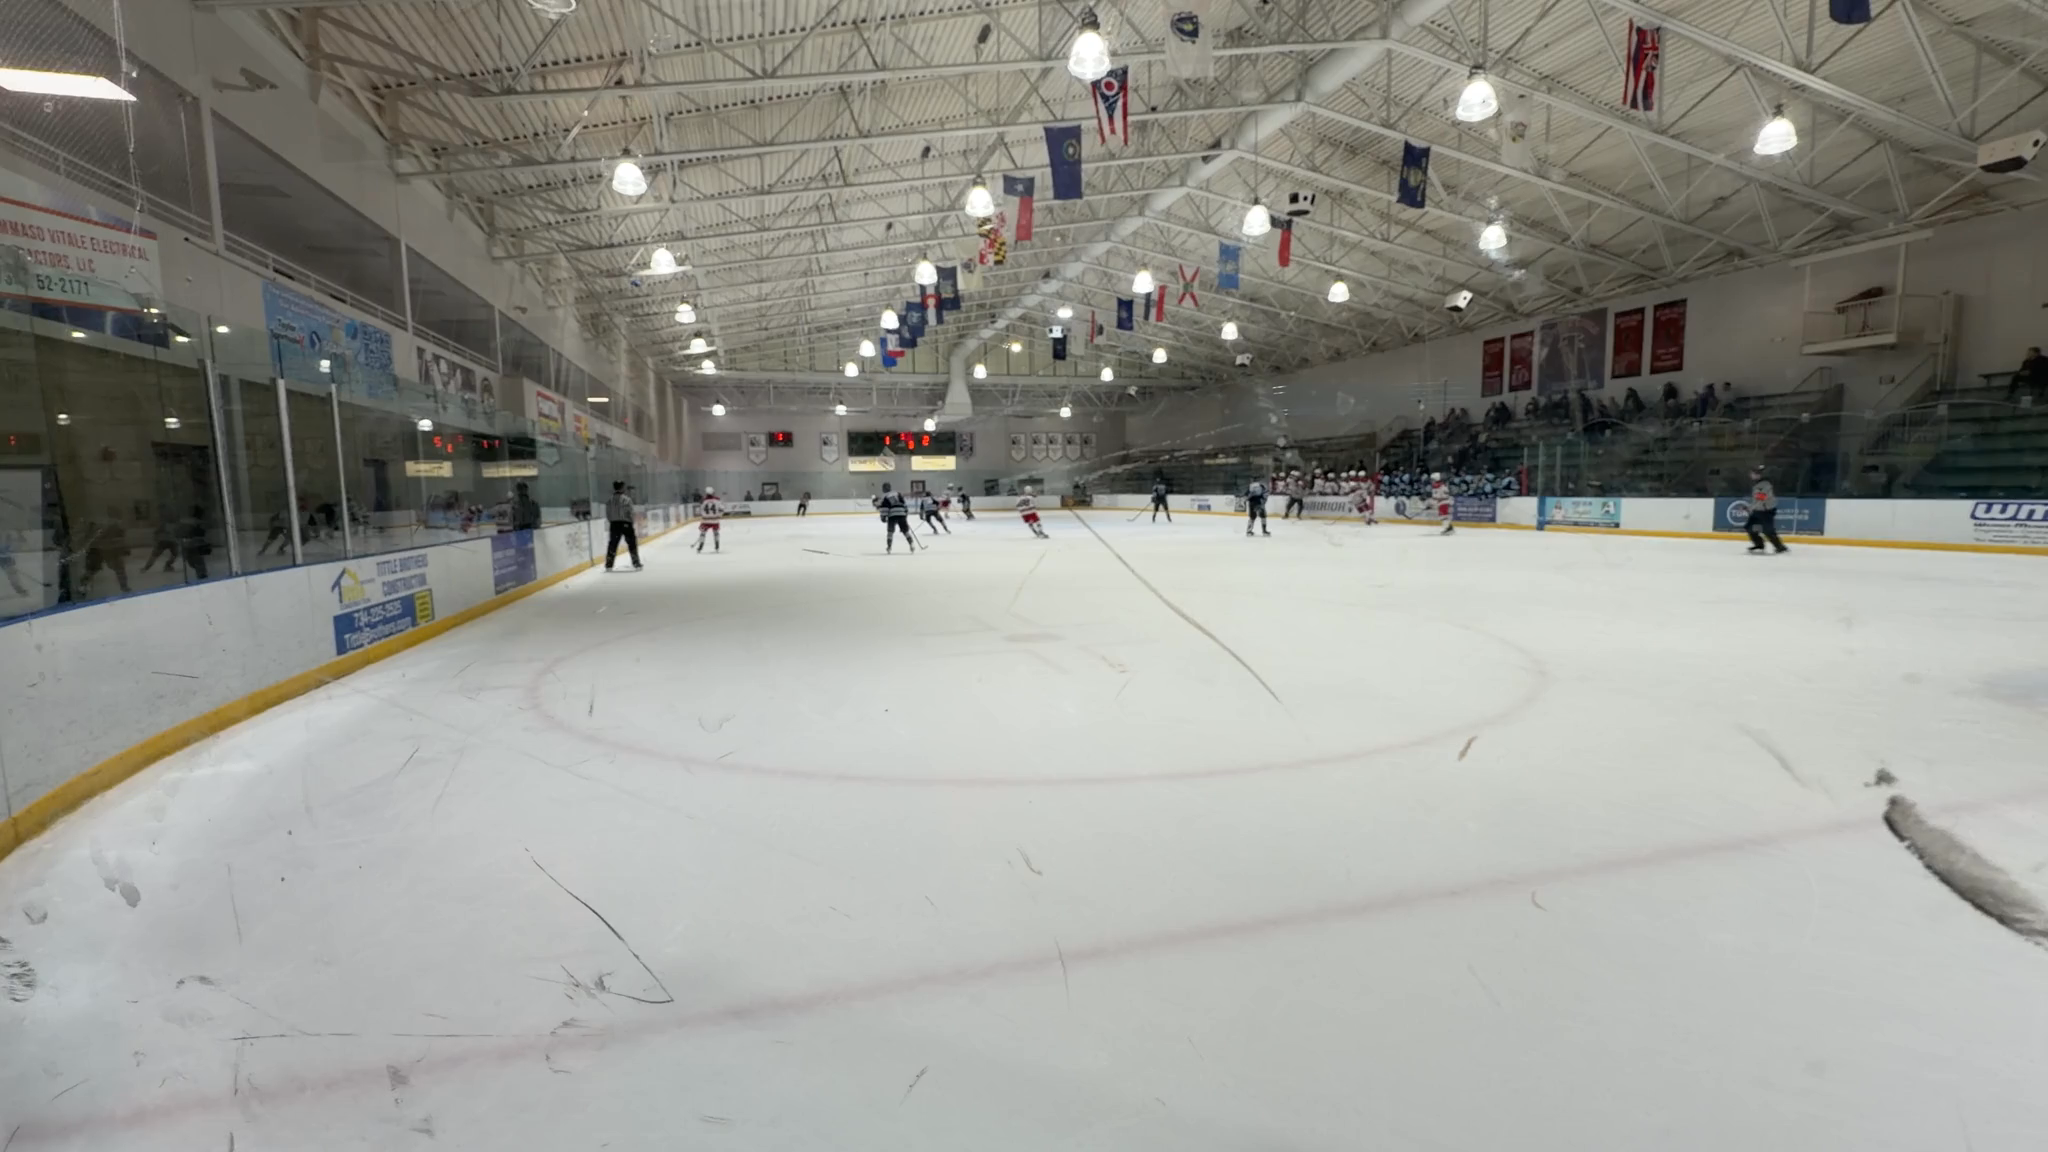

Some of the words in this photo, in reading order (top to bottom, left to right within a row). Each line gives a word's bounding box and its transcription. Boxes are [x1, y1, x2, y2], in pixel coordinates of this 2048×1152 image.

[47, 229, 88, 250] VITALE
[90, 237, 149, 261] ELECTRICAL
[703, 503, 717, 514] 44
